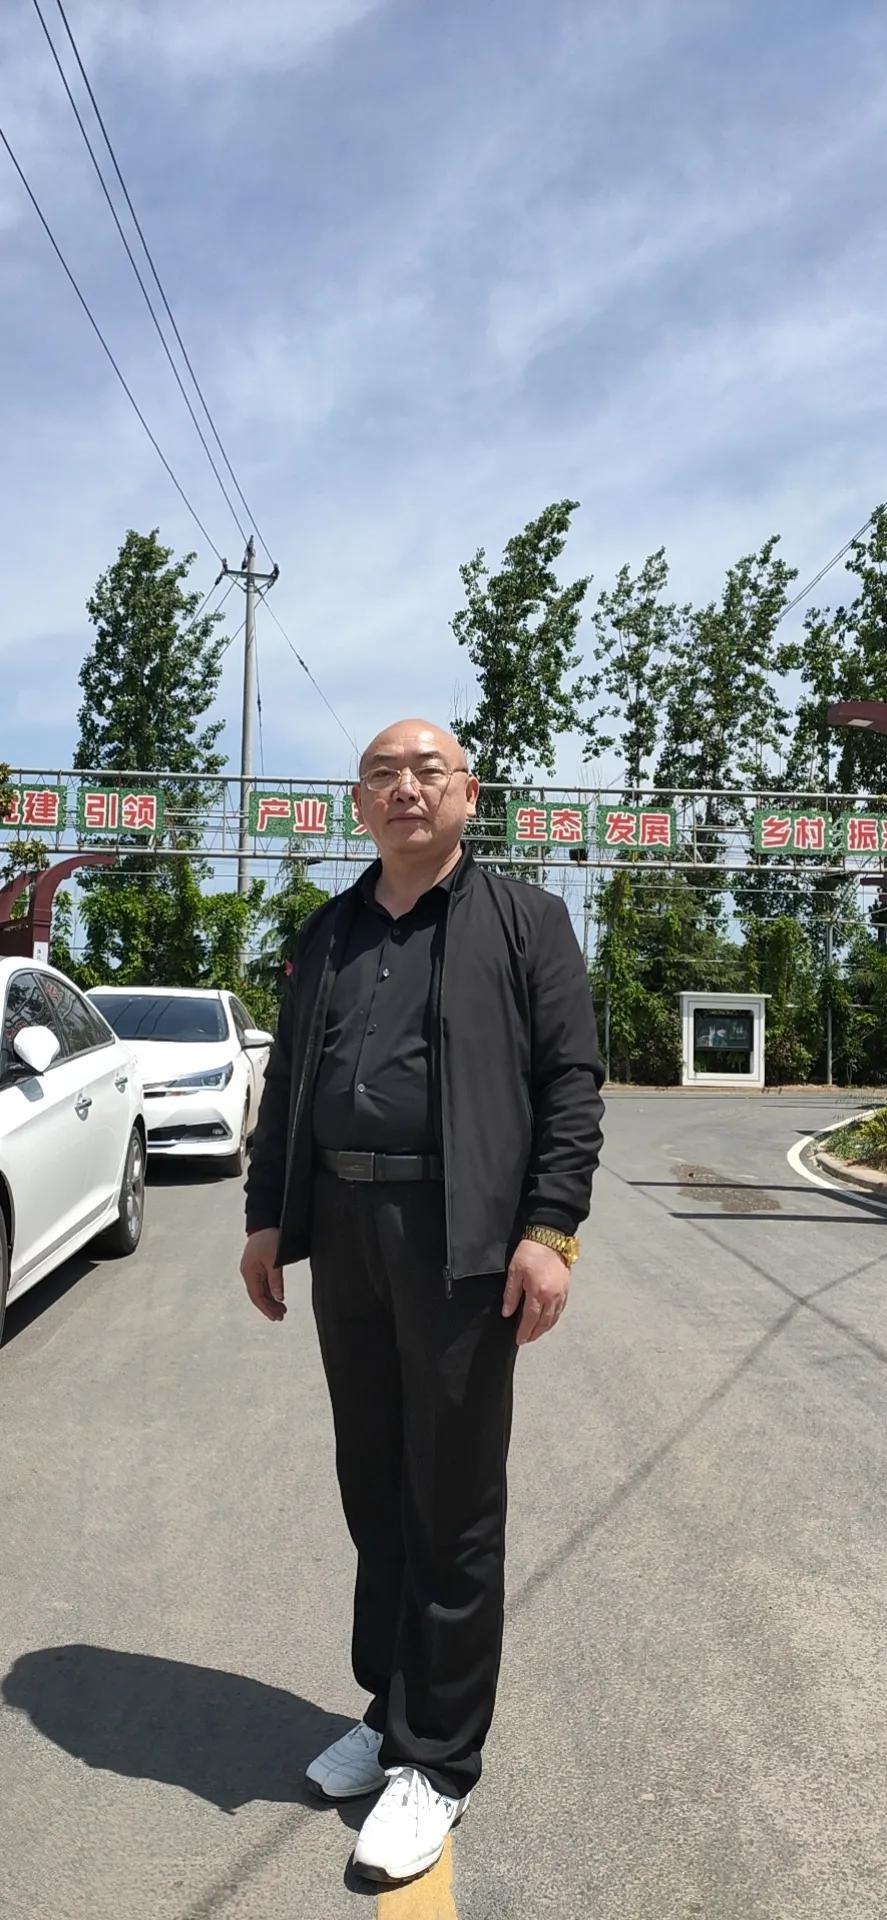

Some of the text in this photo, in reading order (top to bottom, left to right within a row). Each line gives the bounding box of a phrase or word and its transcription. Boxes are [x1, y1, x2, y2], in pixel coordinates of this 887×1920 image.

[85, 792, 157, 829] 引领
[257, 797, 327, 834] 产业
[516, 807, 583, 842] 生态
[605, 811, 671, 847] 发展
[761, 815, 825, 849] 乡村
[848, 818, 887, 851] 振
